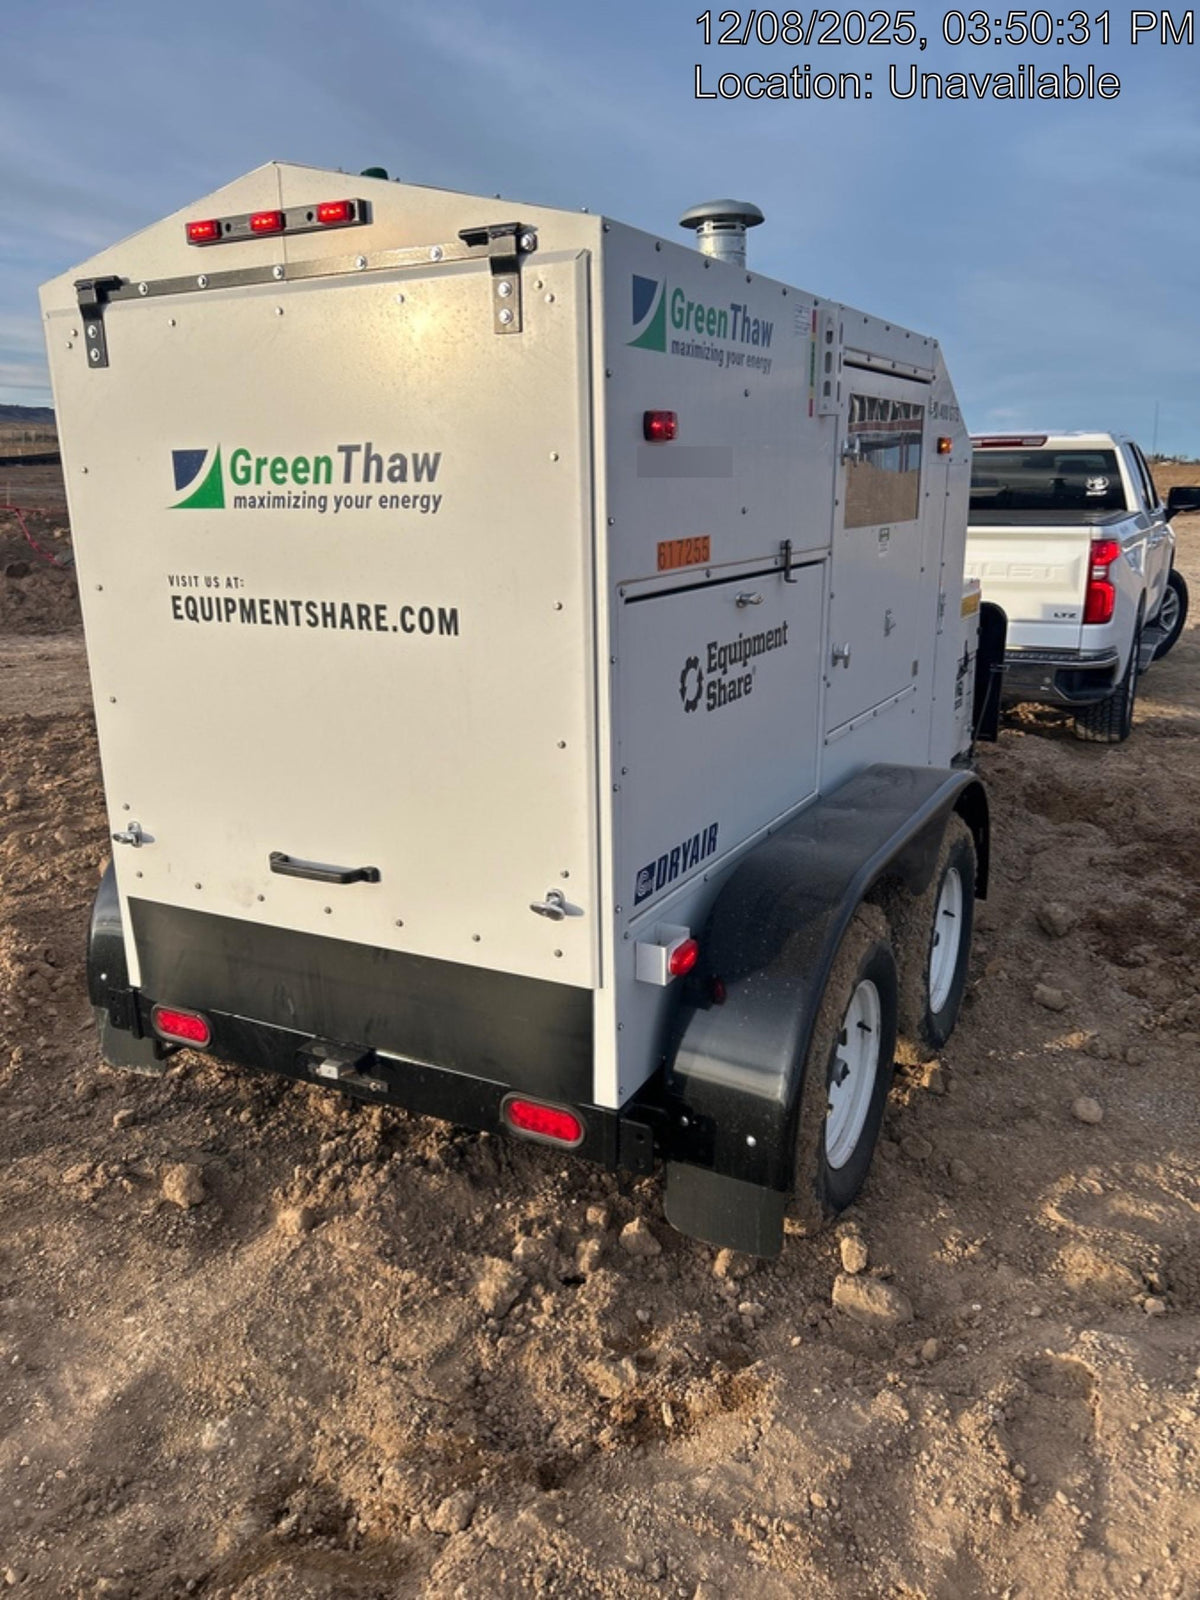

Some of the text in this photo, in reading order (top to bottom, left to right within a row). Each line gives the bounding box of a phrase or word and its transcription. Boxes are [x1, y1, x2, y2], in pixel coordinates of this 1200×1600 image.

[671, 339, 773, 375] maximizing your energy
[233, 491, 443, 514] maximizing your energy
[657, 536, 710, 570] 617255
[168, 575, 244, 590] VISIT US AT:
[171, 595, 460, 636] EQUIPMENTSHARE.COM
[706, 620, 789, 676] Equipment
[706, 671, 753, 712] Share
[655, 822, 719, 892] DRYAIR
